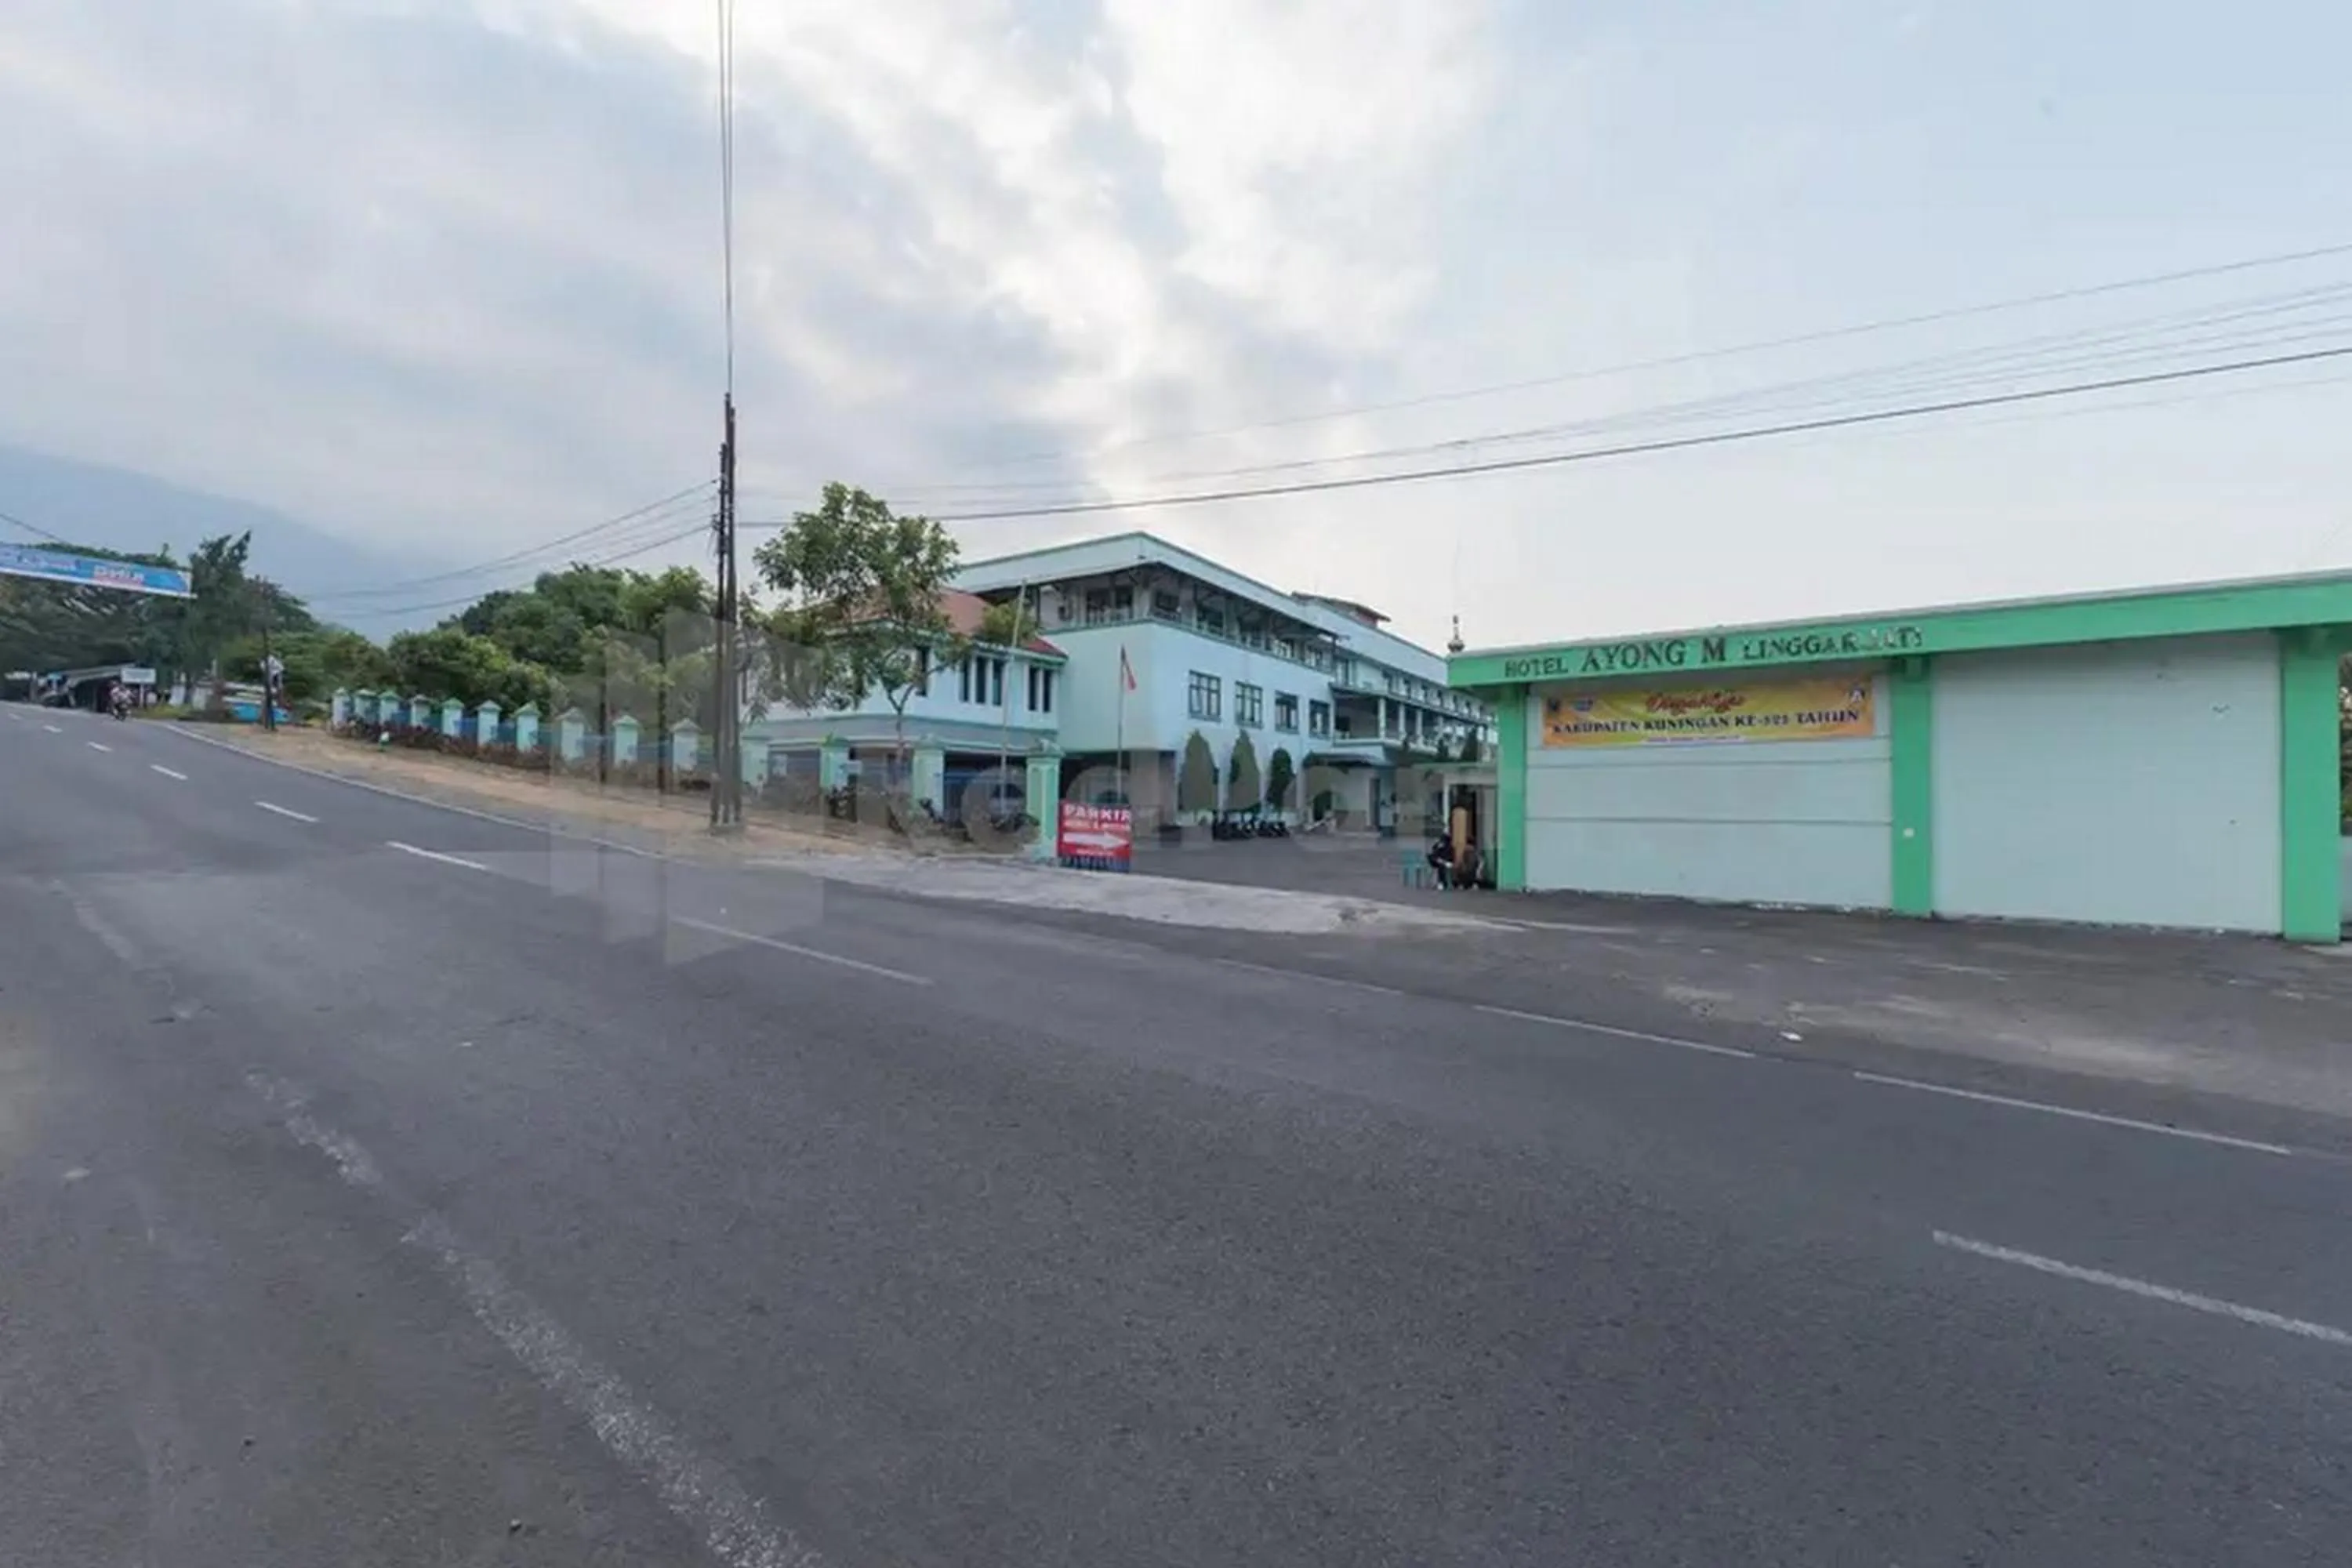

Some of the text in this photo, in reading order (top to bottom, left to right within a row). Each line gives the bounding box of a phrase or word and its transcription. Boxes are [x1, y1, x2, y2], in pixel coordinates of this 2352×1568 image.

[1504, 658, 1568, 678] HOTEL
[1582, 639, 1686, 672] AYONG
[1700, 637, 1727, 663] M
[1643, 717, 1730, 731] KUNINGAN
[1797, 709, 1859, 724] TAHUN
[1063, 804, 1131, 822] PARKIR
